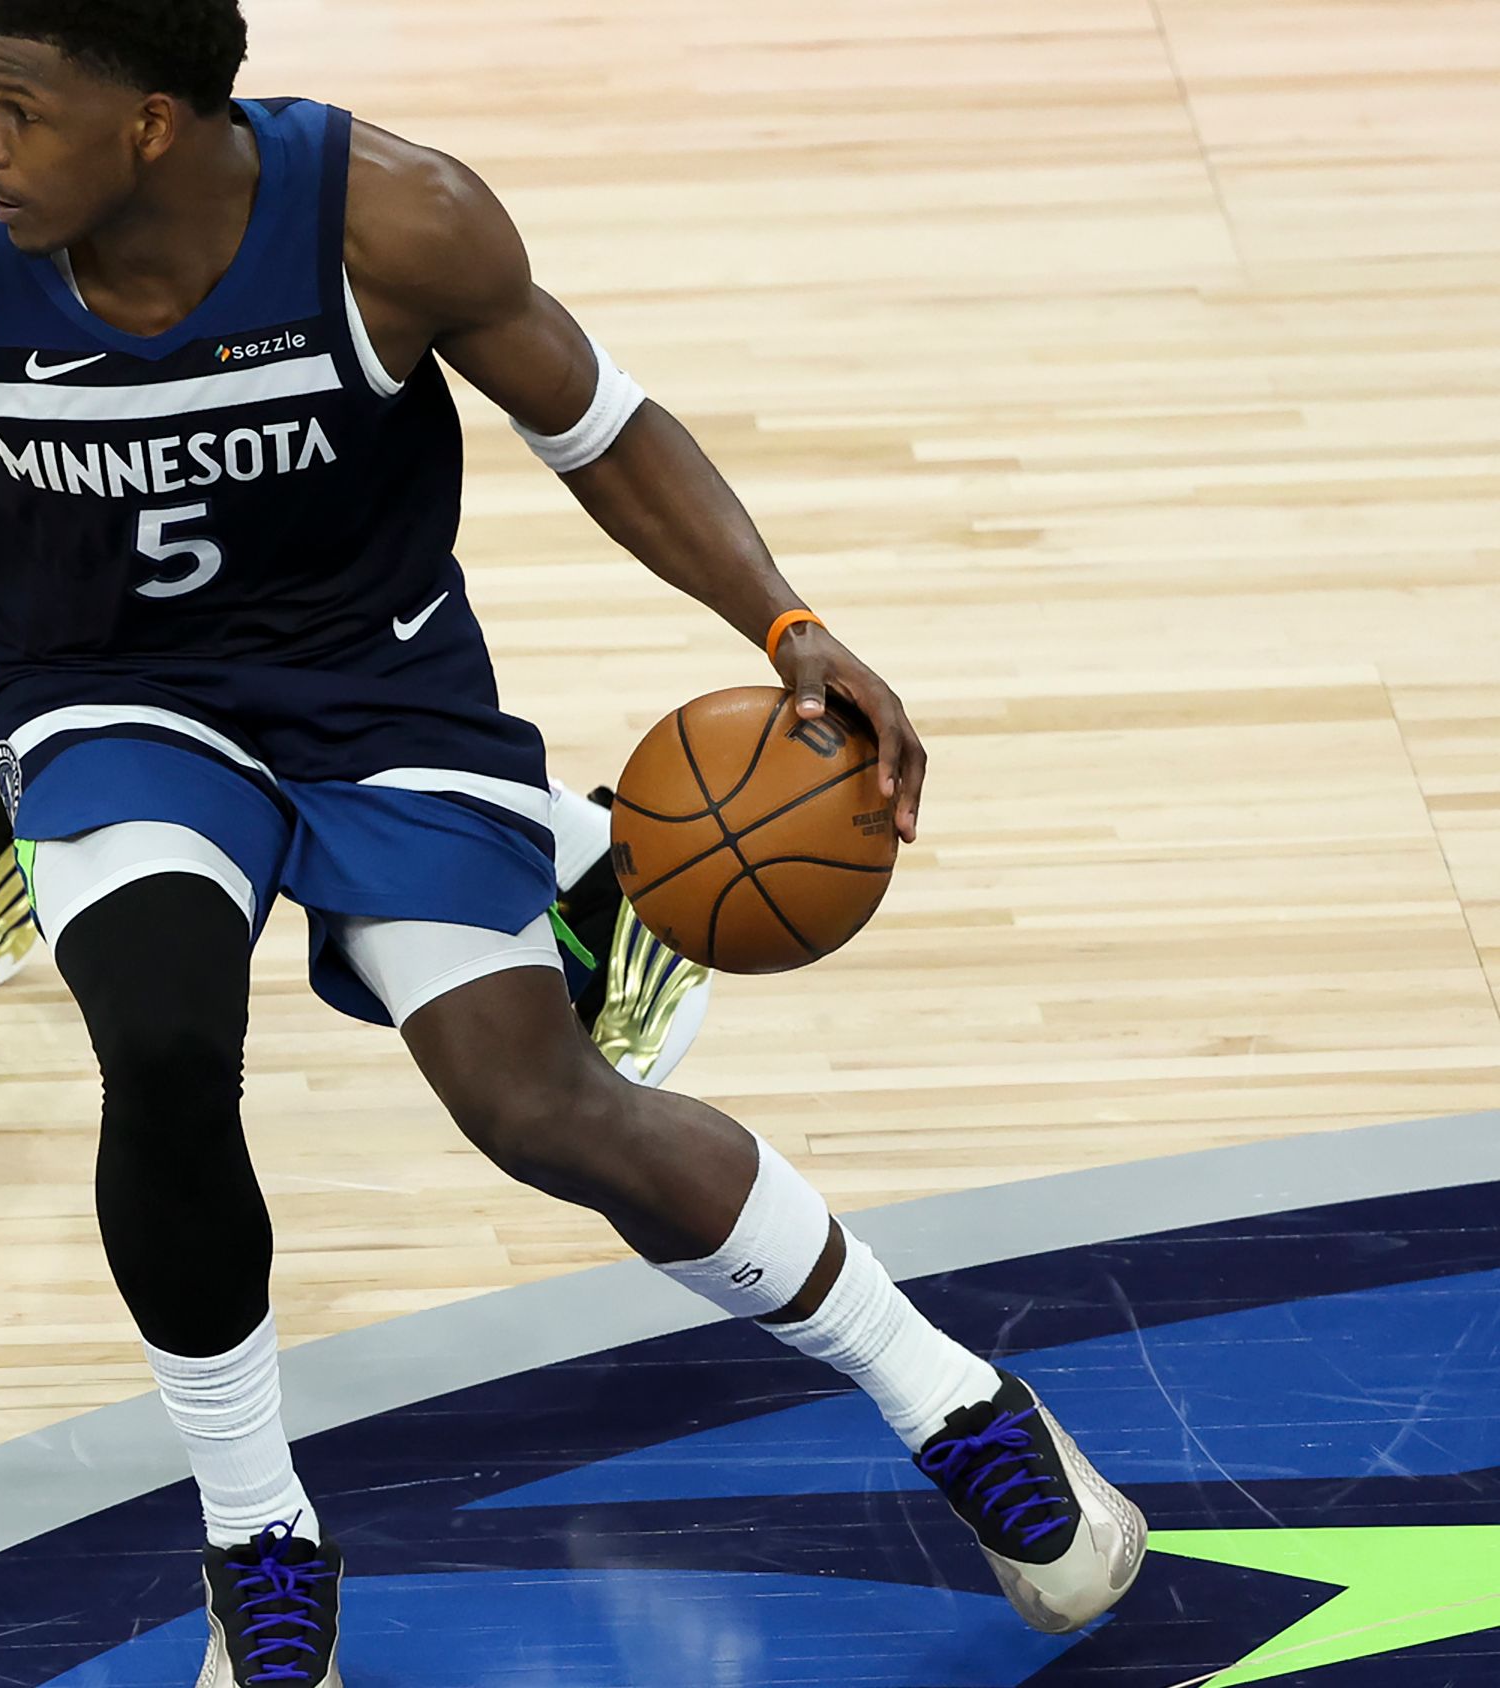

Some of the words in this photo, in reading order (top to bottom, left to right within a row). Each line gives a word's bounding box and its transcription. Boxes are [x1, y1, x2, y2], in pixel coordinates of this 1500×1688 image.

[231, 330, 306, 360] sezzle
[133, 501, 223, 599] 5
[731, 1261, 764, 1290] 5
